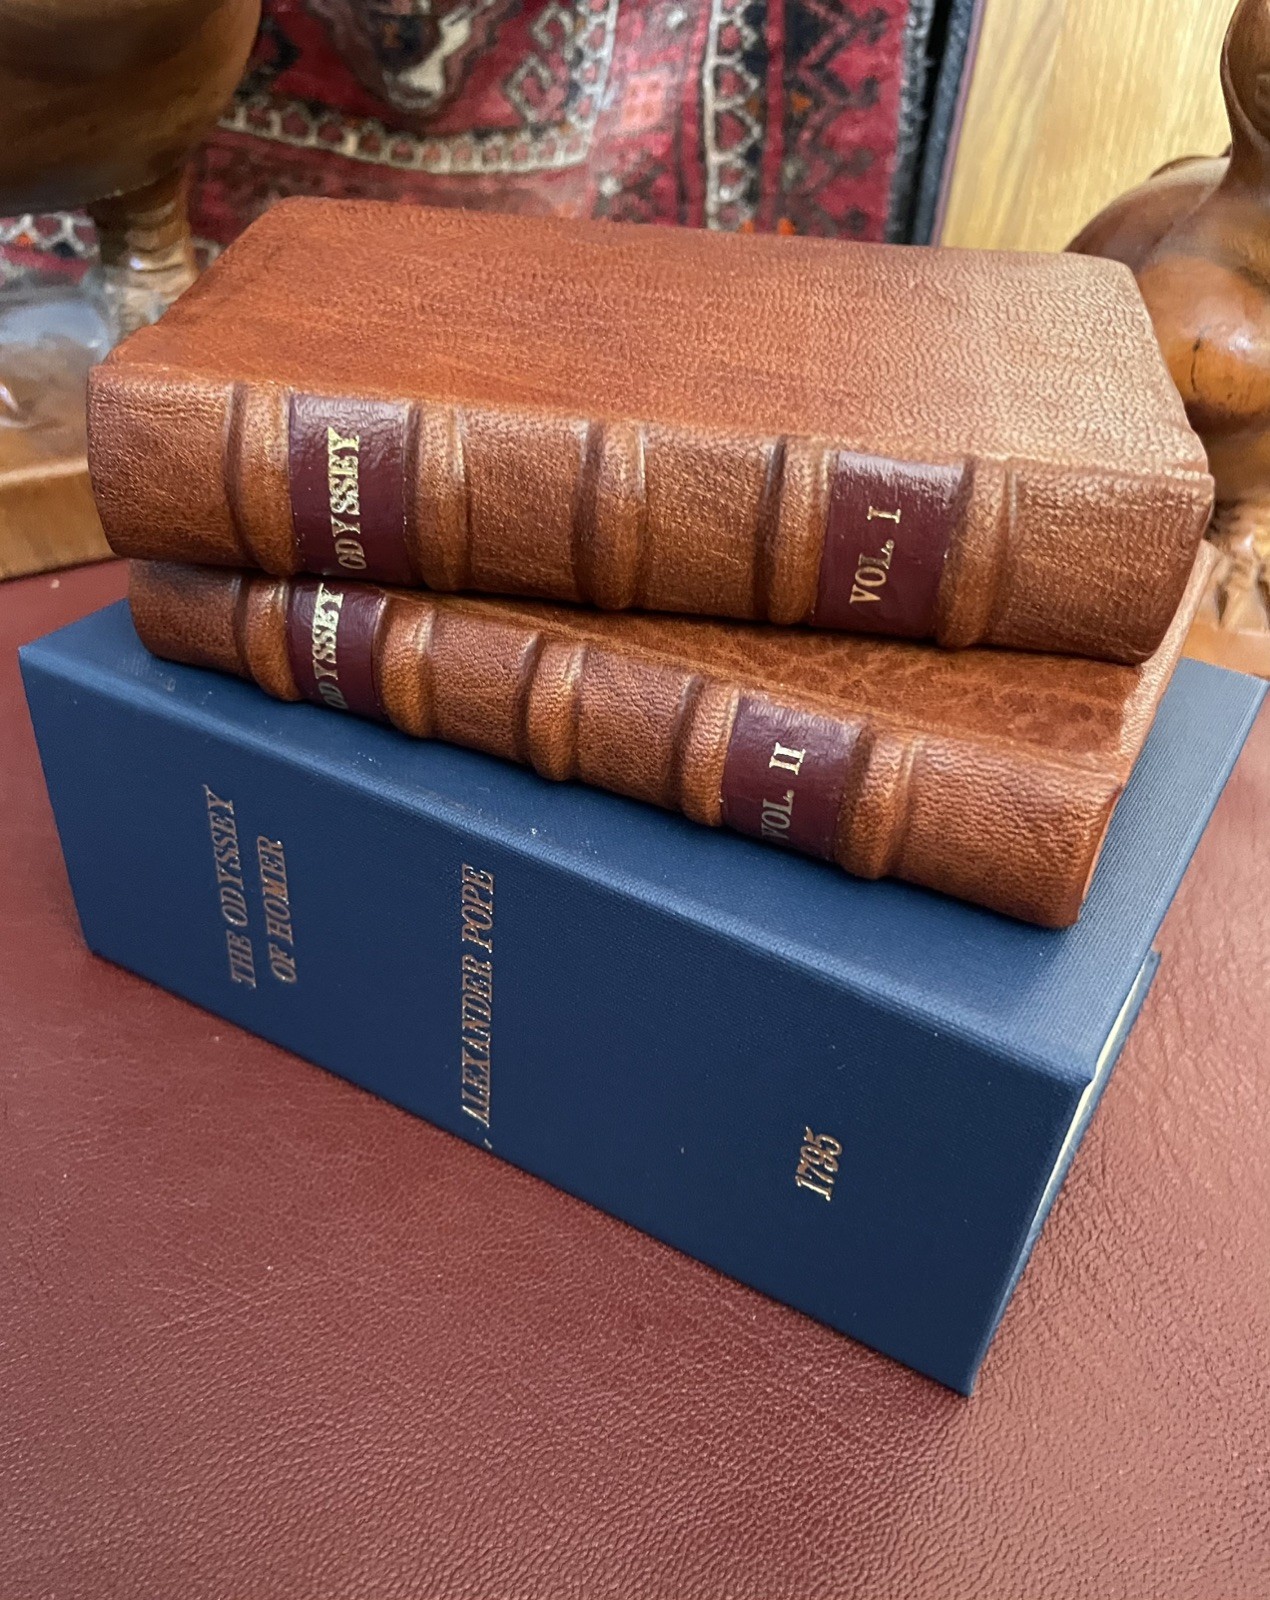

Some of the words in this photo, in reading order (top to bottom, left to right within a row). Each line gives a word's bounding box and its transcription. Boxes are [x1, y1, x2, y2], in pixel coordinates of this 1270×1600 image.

[327, 426, 367, 571] ODYSSEY
[866, 505, 902, 525] I
[849, 539, 895, 604] VOL.
[311, 583, 348, 710] ODYSSEY
[769, 742, 806, 775] II
[202, 783, 248, 927] ODYSSEY
[257, 835, 294, 946] HOMER
[461, 863, 494, 954] POPE
[226, 929, 256, 989] THE
[268, 942, 297, 984] OF
[461, 954, 493, 1128] ALEXANDER
[794, 1126, 843, 1202] 1795
